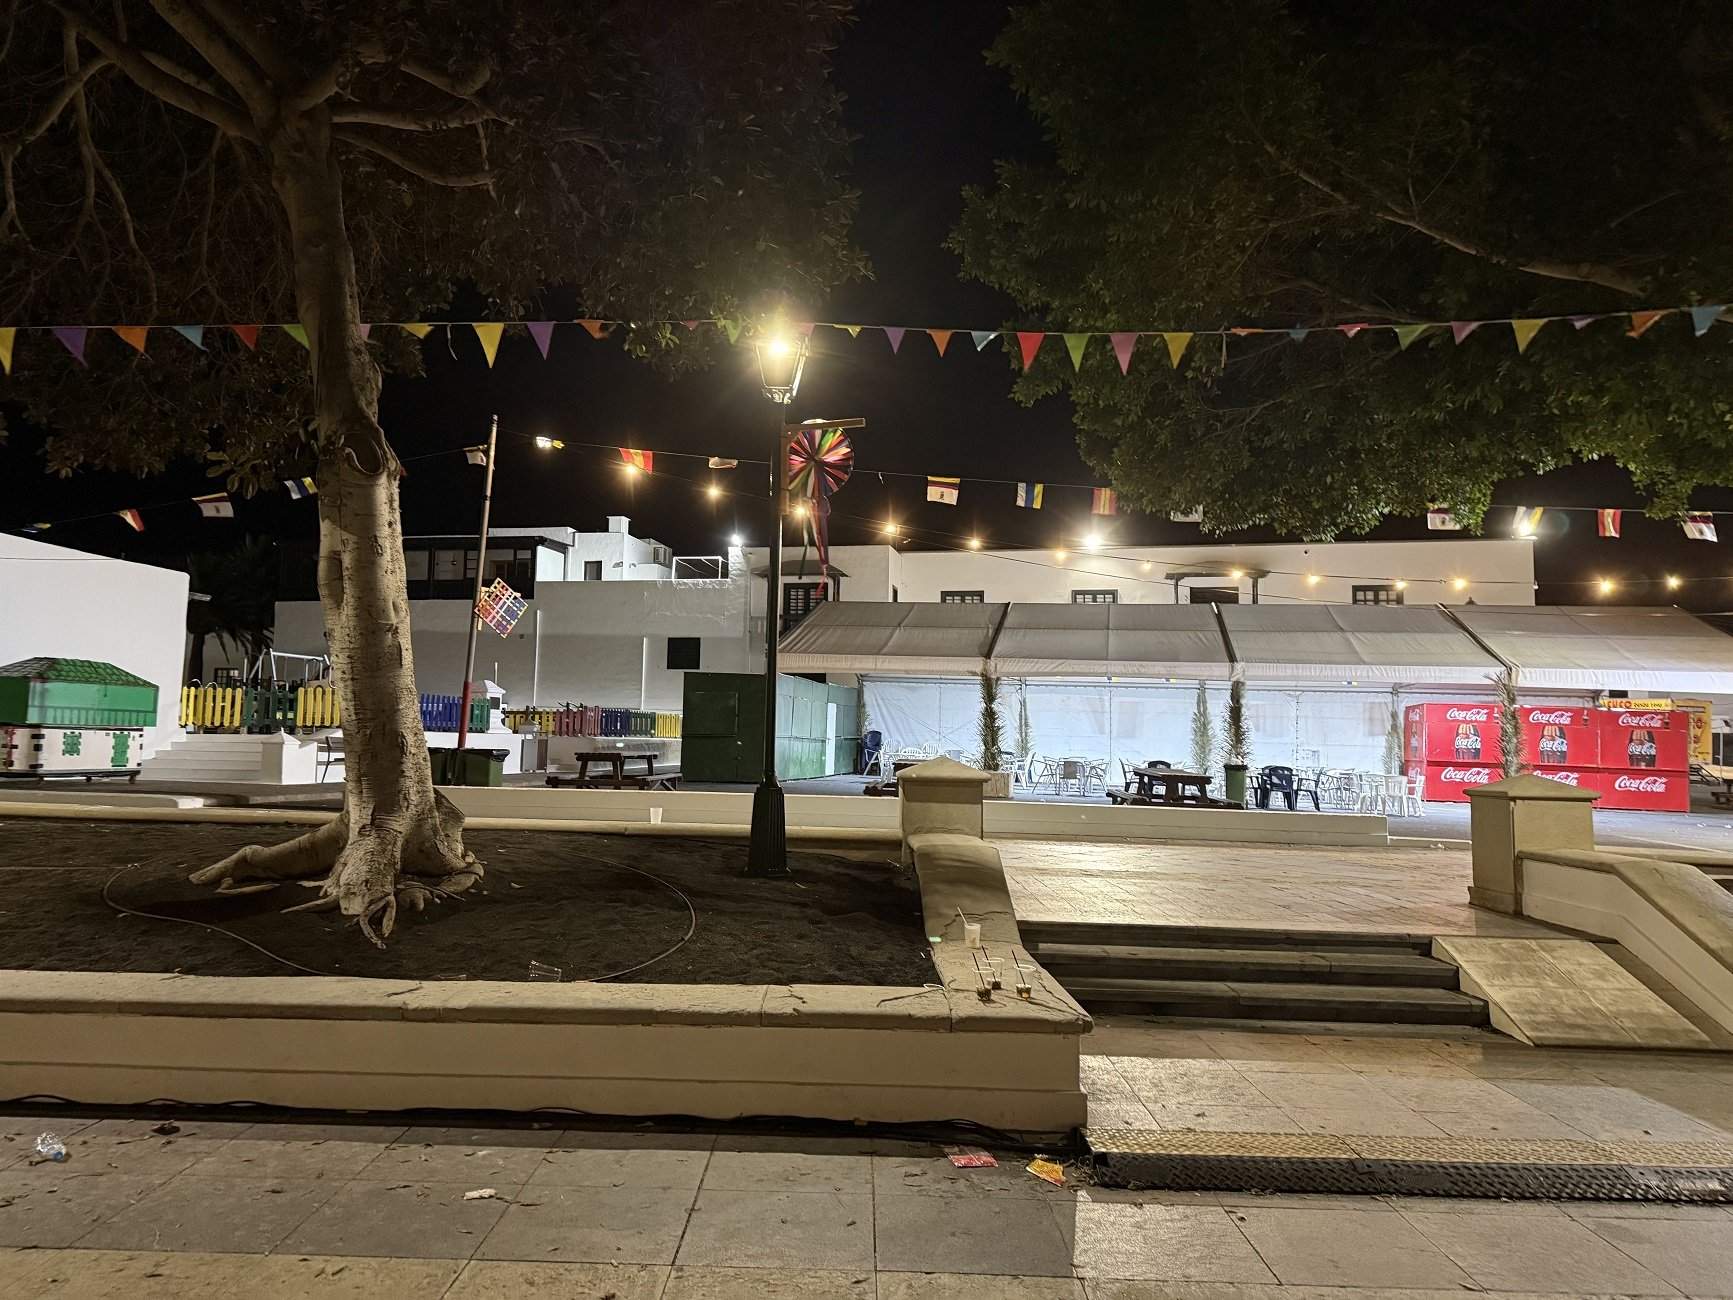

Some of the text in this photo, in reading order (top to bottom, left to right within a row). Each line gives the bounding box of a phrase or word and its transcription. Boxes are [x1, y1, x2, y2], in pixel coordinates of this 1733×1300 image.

[1446, 708, 1489, 721] Coca-Cola
[1529, 710, 1574, 725] Coca-Cola
[1618, 713, 1663, 727] Coca-Cola
[1441, 767, 1491, 783] Coca-Cola
[1614, 775, 1668, 793] Coca-Cola
